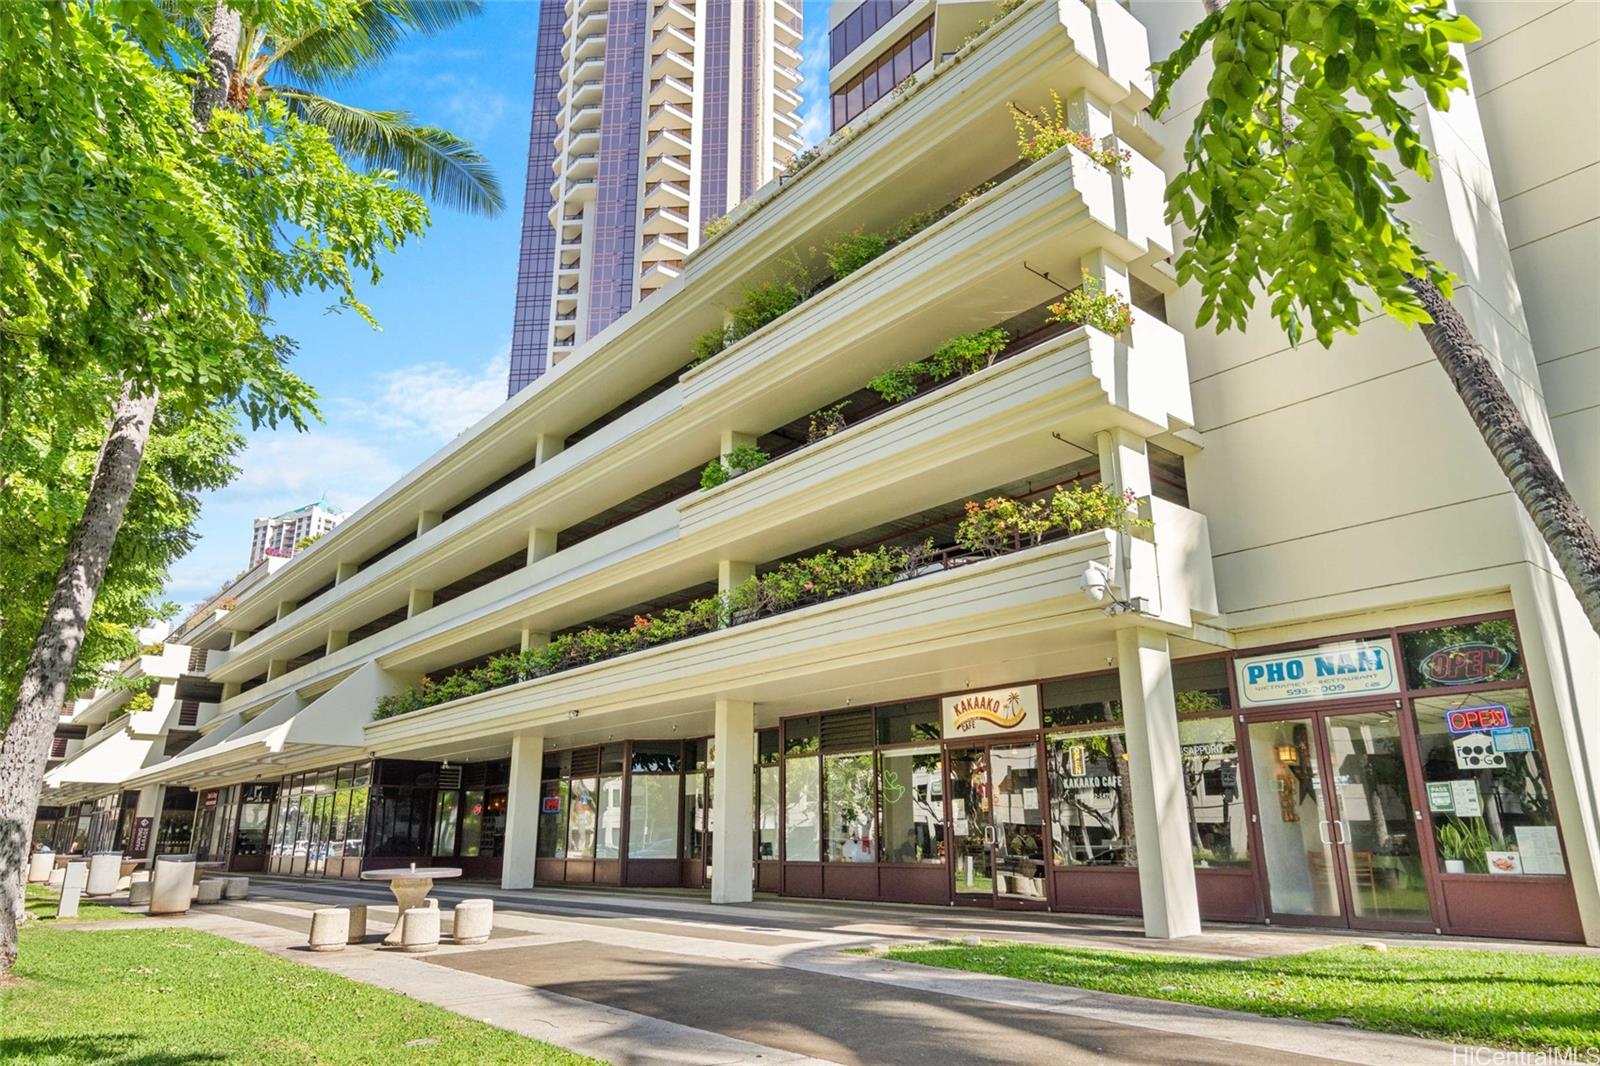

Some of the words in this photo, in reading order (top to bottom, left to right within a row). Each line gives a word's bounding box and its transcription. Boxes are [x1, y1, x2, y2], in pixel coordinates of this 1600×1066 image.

[1247, 659, 1304, 685] PHO
[1314, 649, 1384, 677] NAM
[1430, 649, 1500, 679] OPEN
[1318, 673, 1378, 684] RESTAURANT
[953, 696, 1000, 717] KAKAAKO
[1451, 709, 1506, 730] OPEN
[1182, 744, 1224, 755] SAPPORO
[1462, 754, 1504, 766] TO-GO
[1063, 776, 1101, 788] KAKAAKO
[1101, 775, 1122, 787] CAFE
